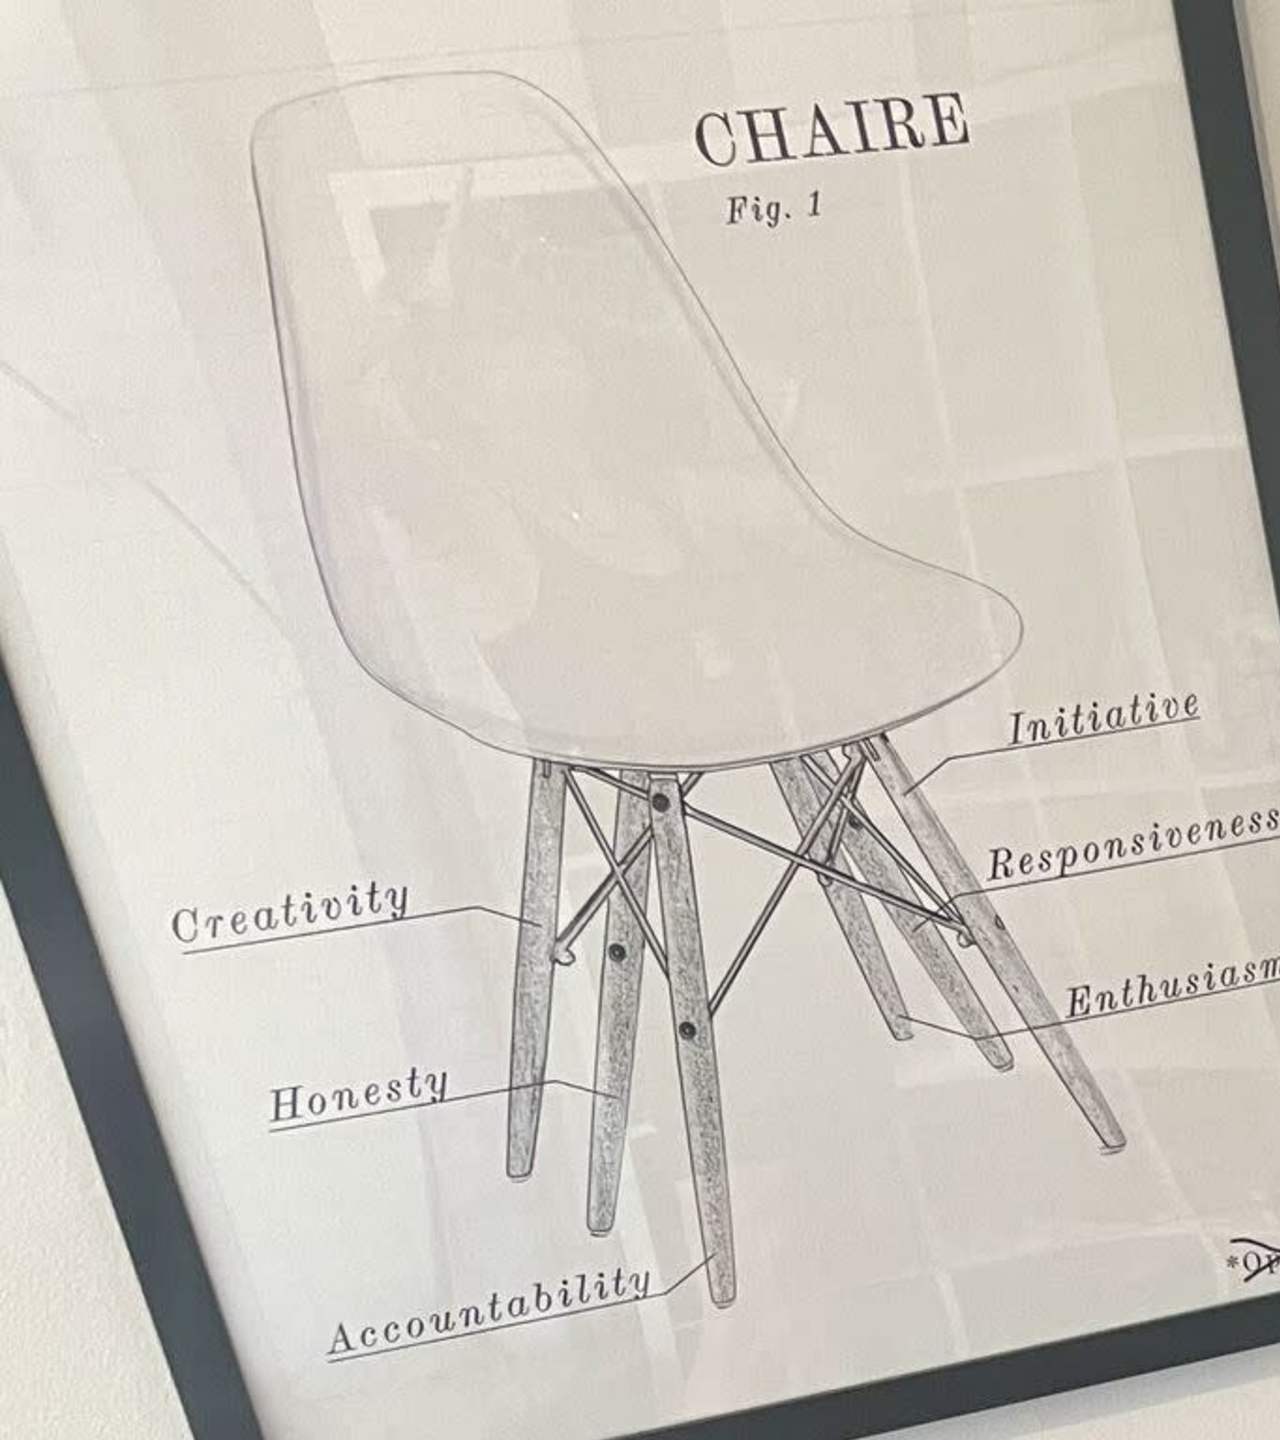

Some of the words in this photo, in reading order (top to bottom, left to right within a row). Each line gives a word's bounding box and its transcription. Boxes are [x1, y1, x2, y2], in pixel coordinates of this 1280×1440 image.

[695, 92, 970, 168] CHAIRE
[725, 195, 791, 228] Fig.
[808, 190, 821, 217] 1
[1007, 693, 1200, 745] Initiative
[986, 807, 1280, 882] Responsiveness
[172, 881, 409, 943] Creativity
[269, 1067, 448, 1122] Honesty
[326, 1267, 651, 1354] Accountability
